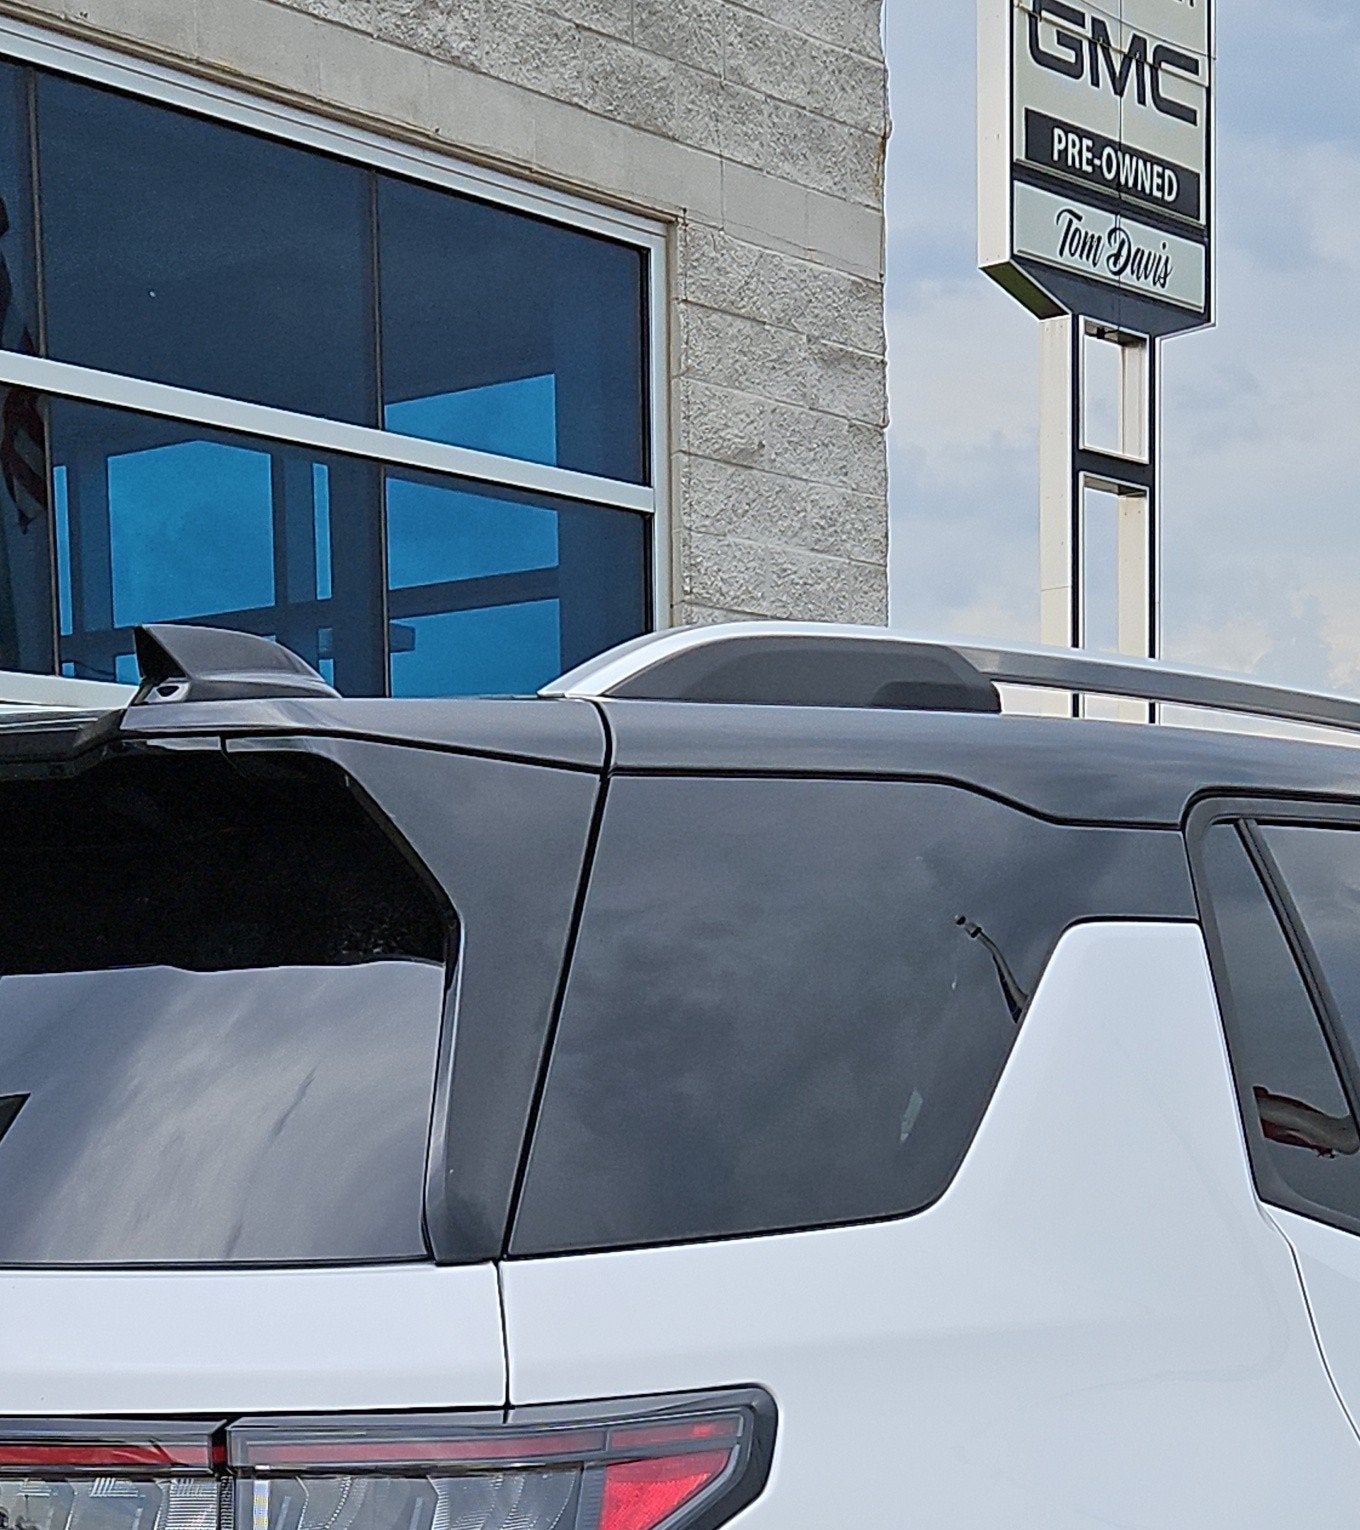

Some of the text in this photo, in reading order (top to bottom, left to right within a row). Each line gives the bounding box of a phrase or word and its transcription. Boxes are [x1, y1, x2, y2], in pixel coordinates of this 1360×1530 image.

[1029, 0, 1200, 127] GMC
[1053, 127, 1178, 202] PRE-OWNED
[1056, 208, 1174, 289] Tom Davis
